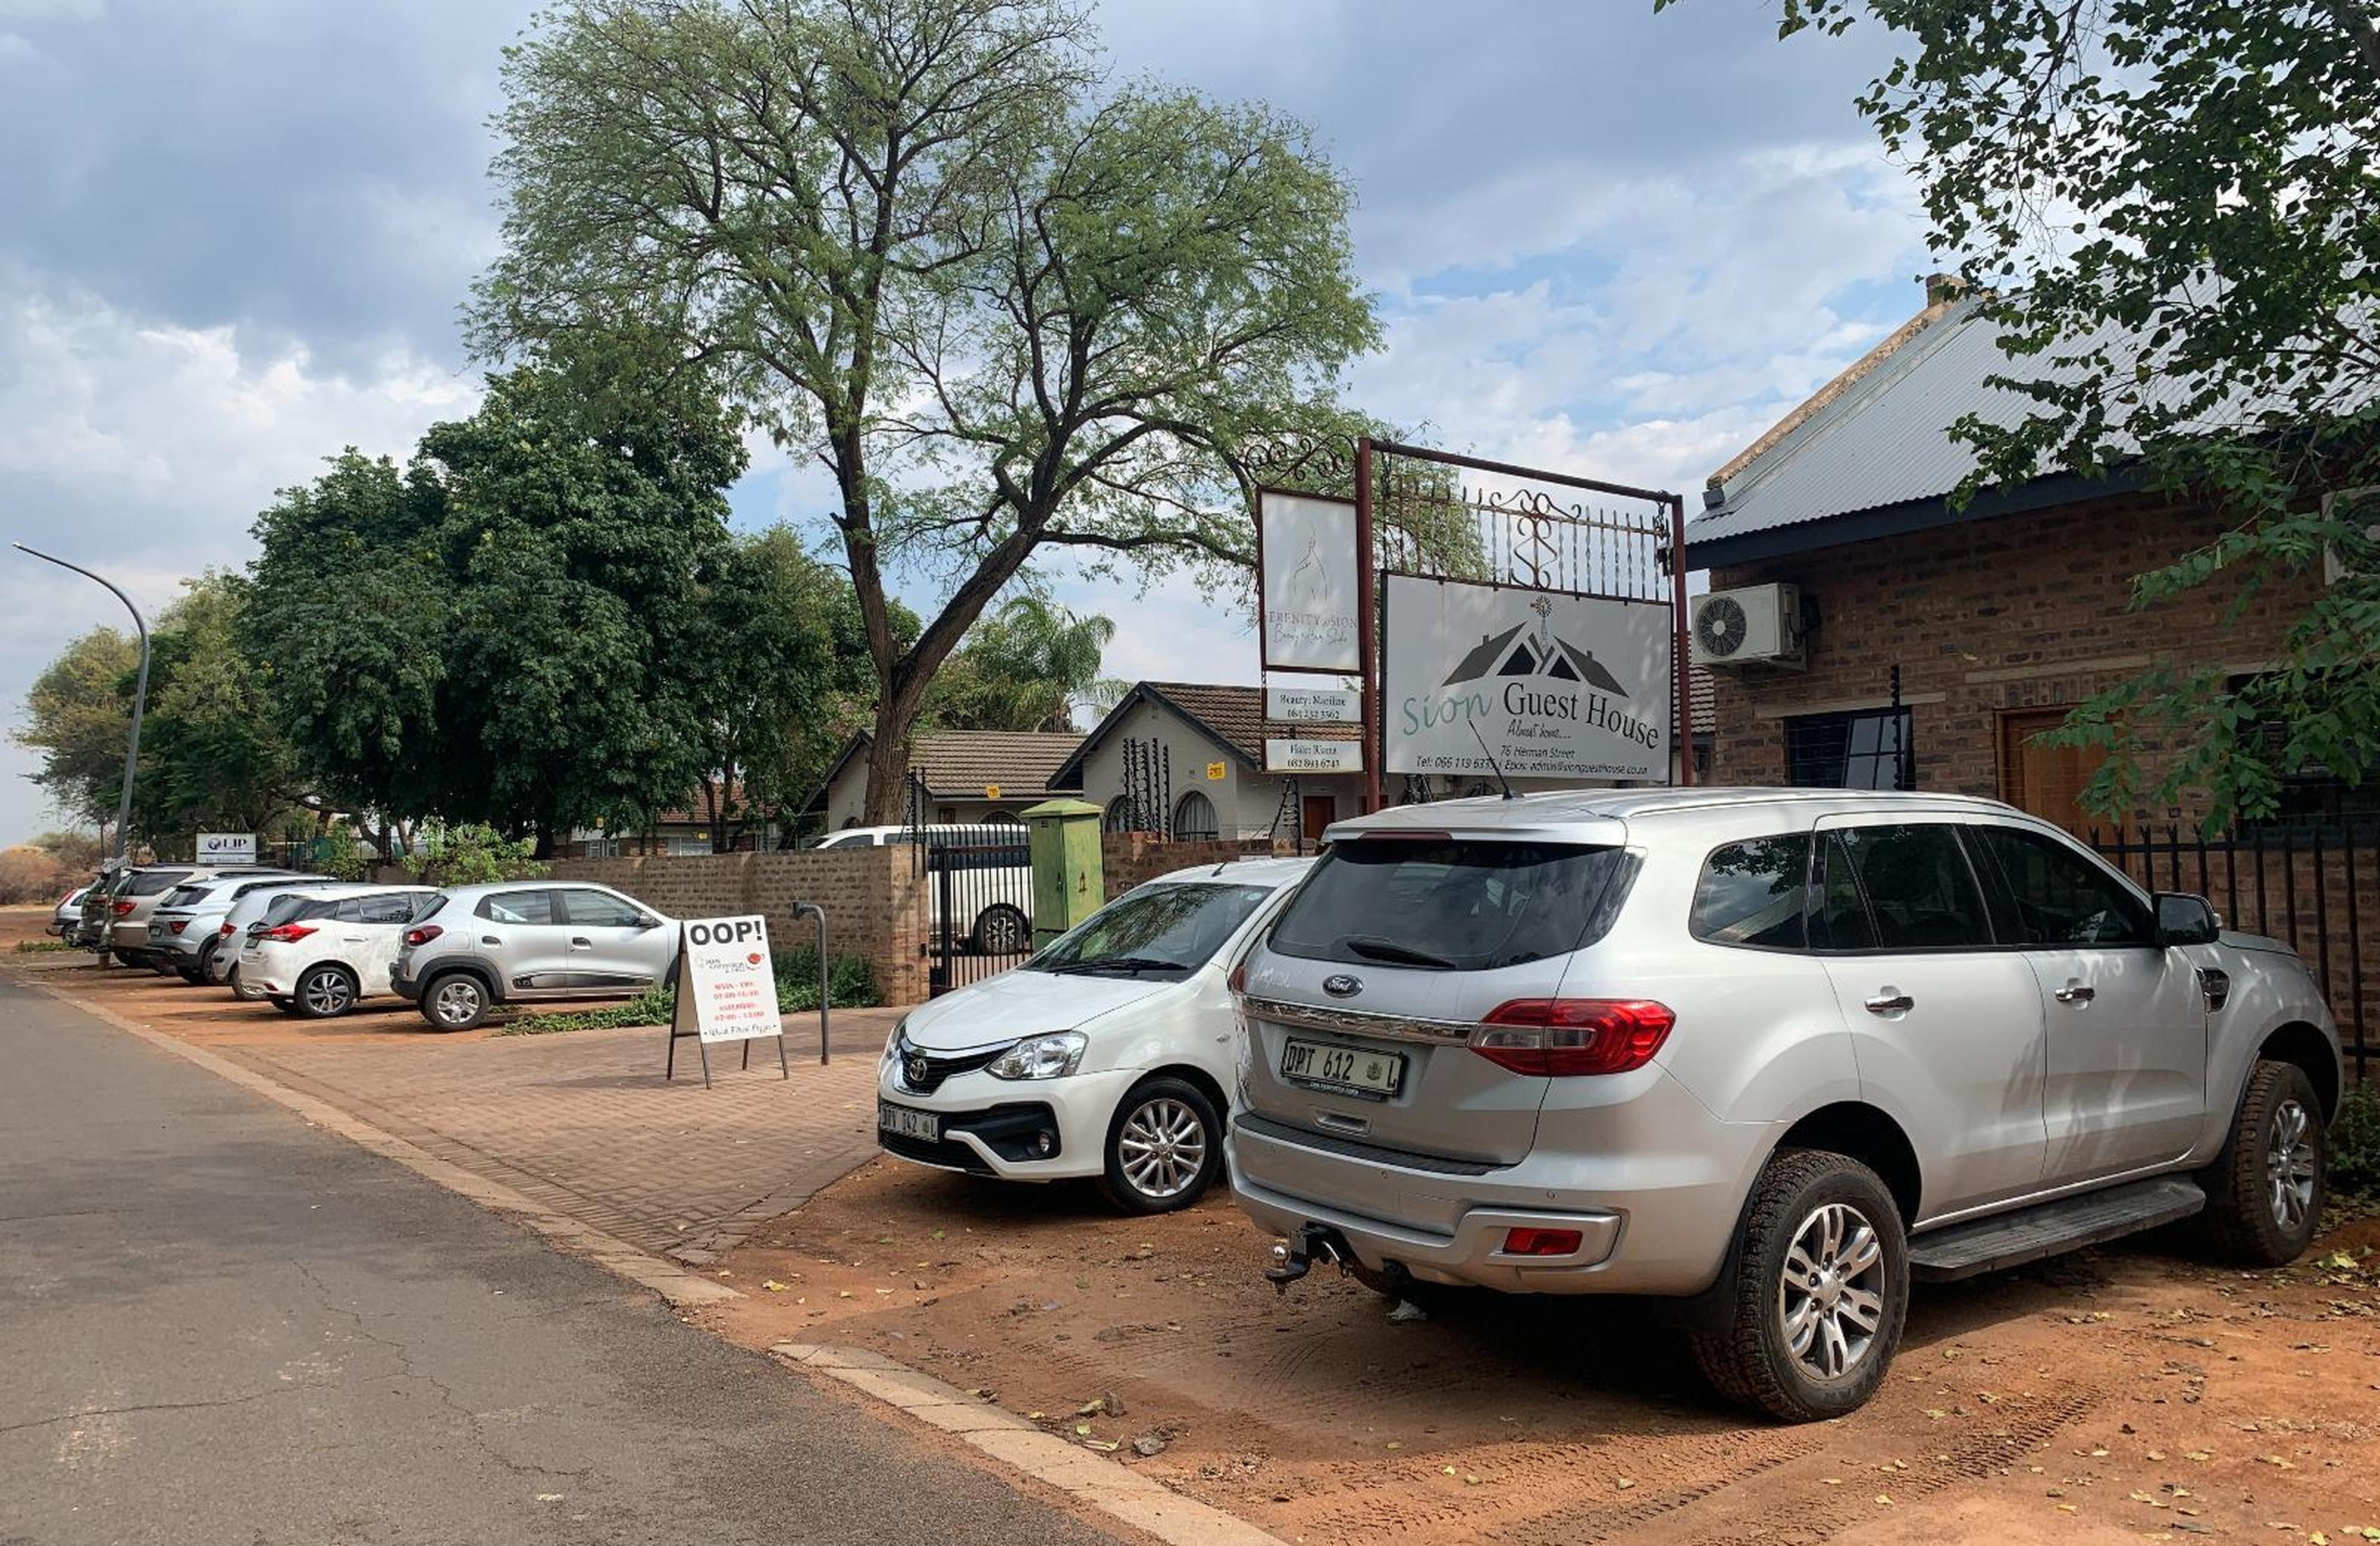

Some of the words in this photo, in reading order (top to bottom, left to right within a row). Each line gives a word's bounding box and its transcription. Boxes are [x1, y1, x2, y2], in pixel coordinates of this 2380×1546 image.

[1403, 692, 1492, 736] Sion
[1502, 682, 1578, 720] Guest
[1586, 692, 1659, 749] House
[1416, 755, 1432, 767] Tel:
[1514, 745, 1548, 758] Herman
[1549, 747, 1576, 759] Street
[690, 921, 762, 945] OOP!
[1286, 1045, 1316, 1074] DPT
[1323, 1050, 1354, 1081] 612
[1387, 1060, 1397, 1088] L
